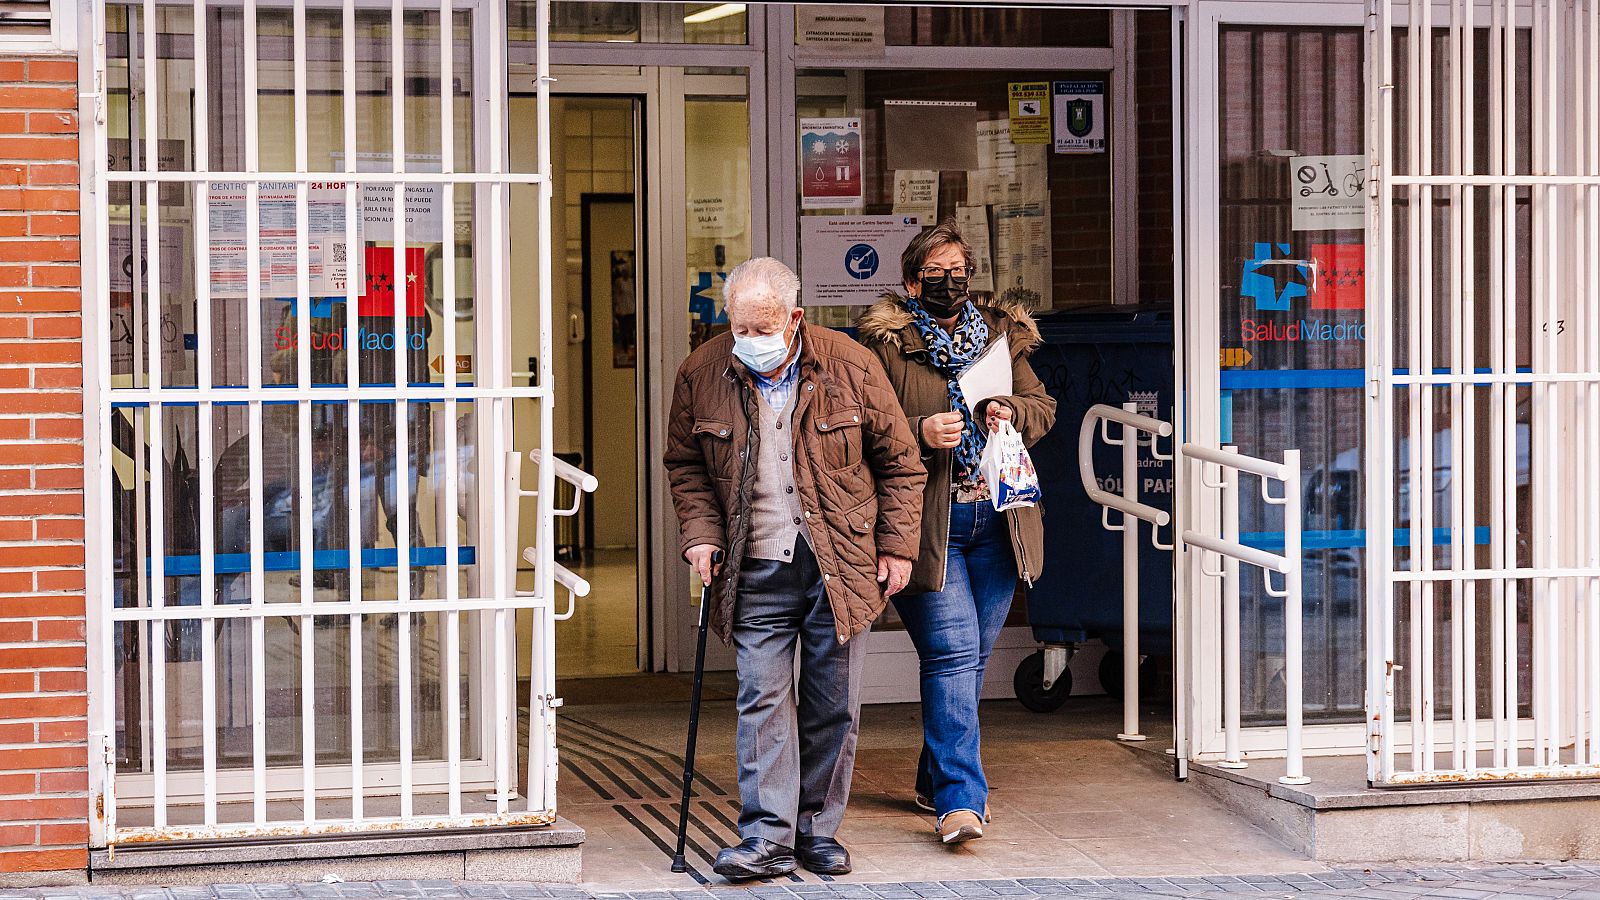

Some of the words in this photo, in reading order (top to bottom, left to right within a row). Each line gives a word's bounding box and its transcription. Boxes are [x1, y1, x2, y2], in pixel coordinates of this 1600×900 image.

[456, 360, 470, 368] AC
[1137, 458, 1163, 468] adrid
[1095, 474, 1123, 492] SÓL
